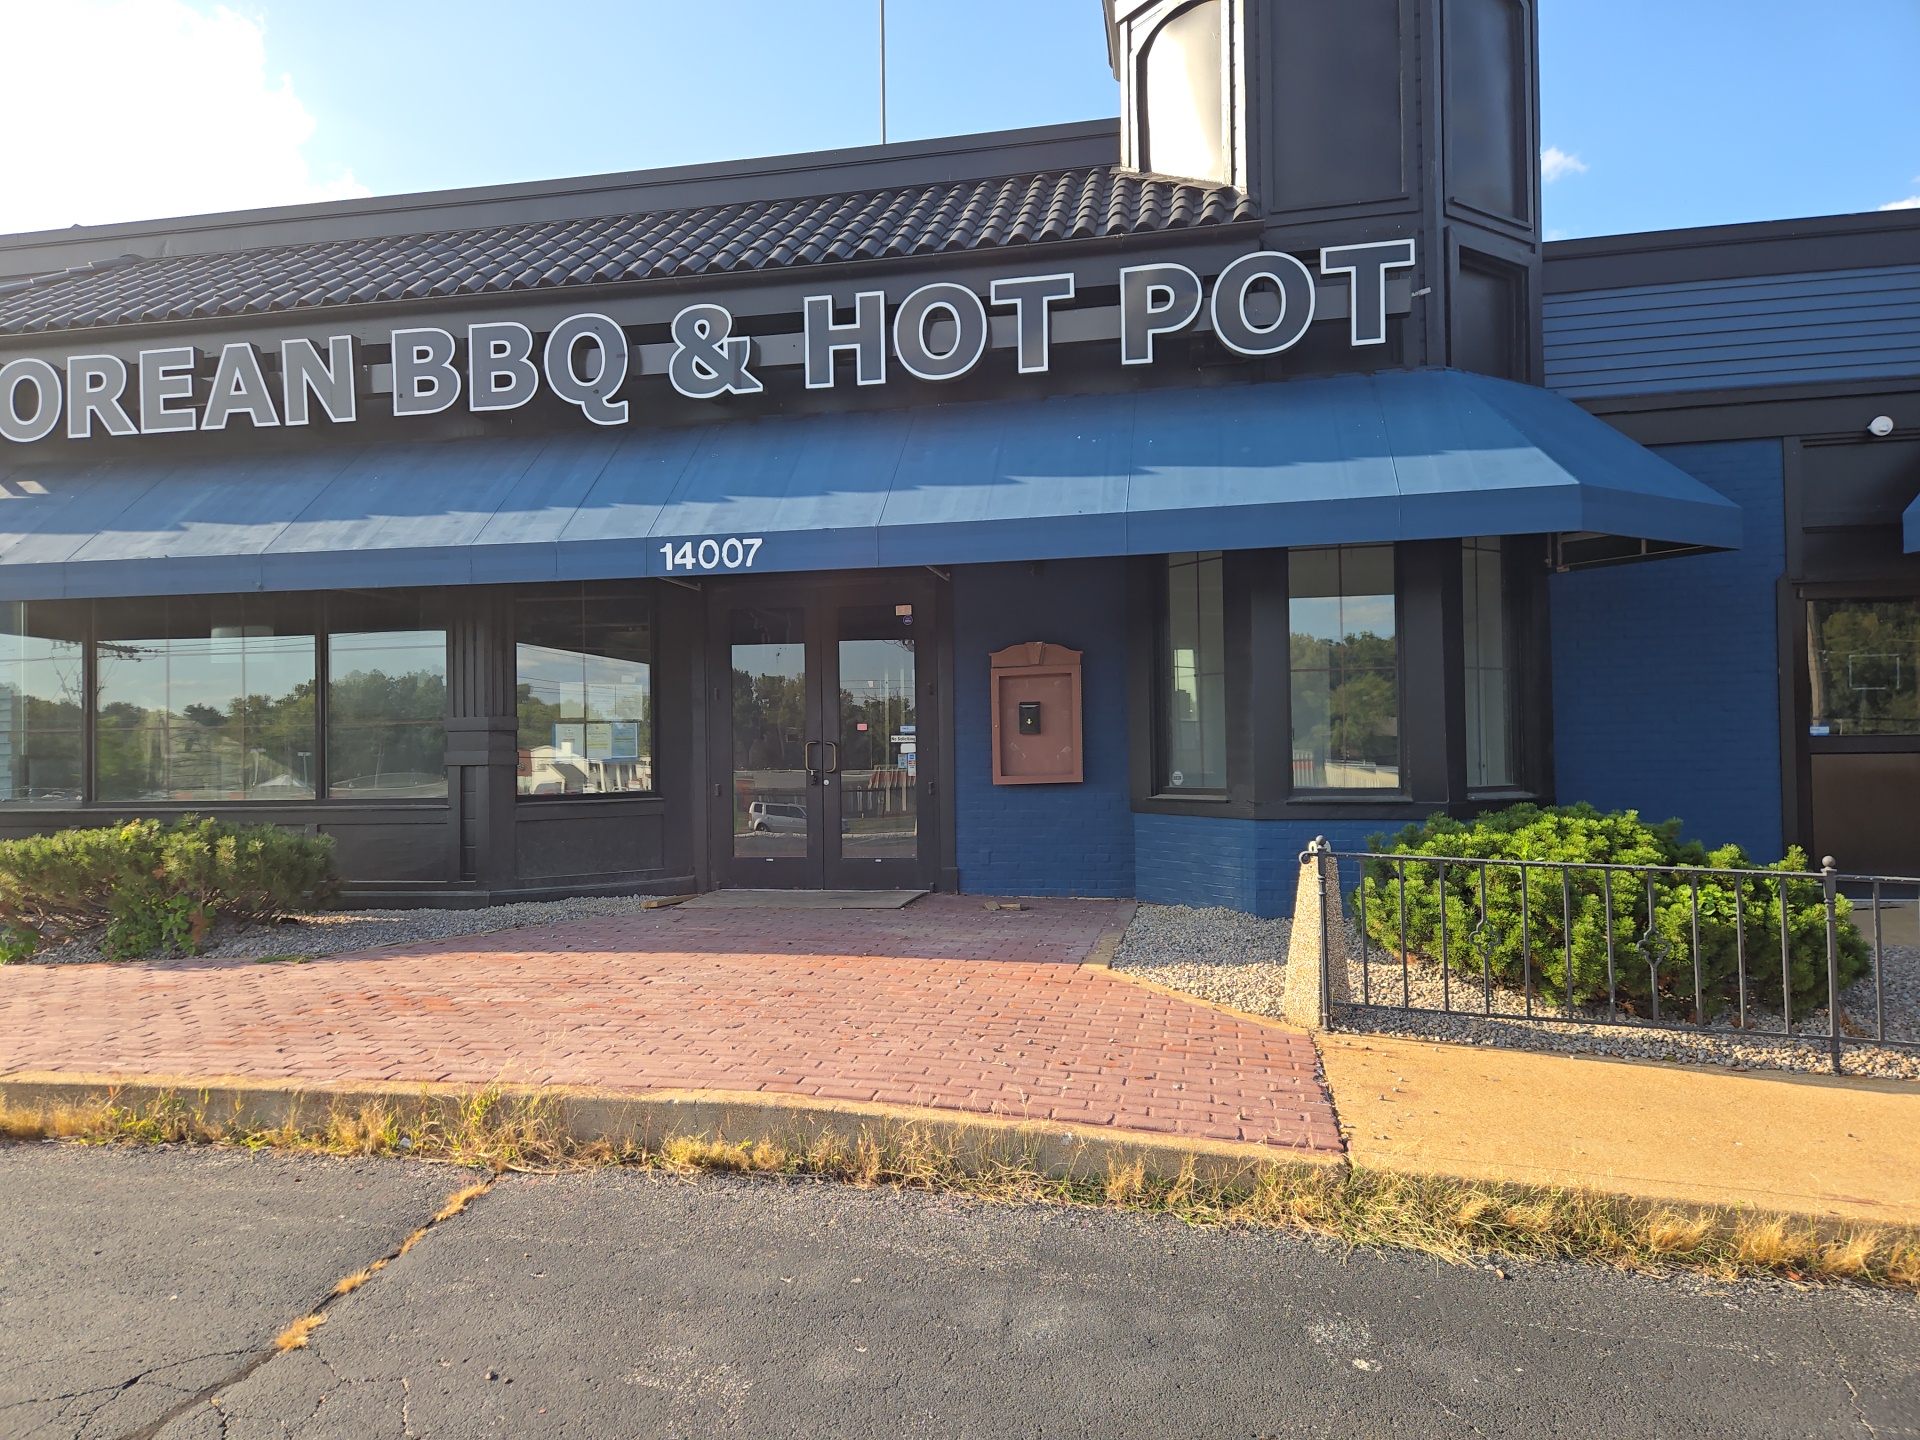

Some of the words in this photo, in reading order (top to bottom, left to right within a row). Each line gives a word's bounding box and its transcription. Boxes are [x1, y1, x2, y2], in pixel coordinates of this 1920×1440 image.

[0, 335, 356, 442] OREAN
[391, 313, 629, 425] BBQ
[669, 303, 764, 399] &
[803, 272, 1075, 389] HOT
[1120, 238, 1416, 366] POT
[659, 537, 763, 571] 14007
